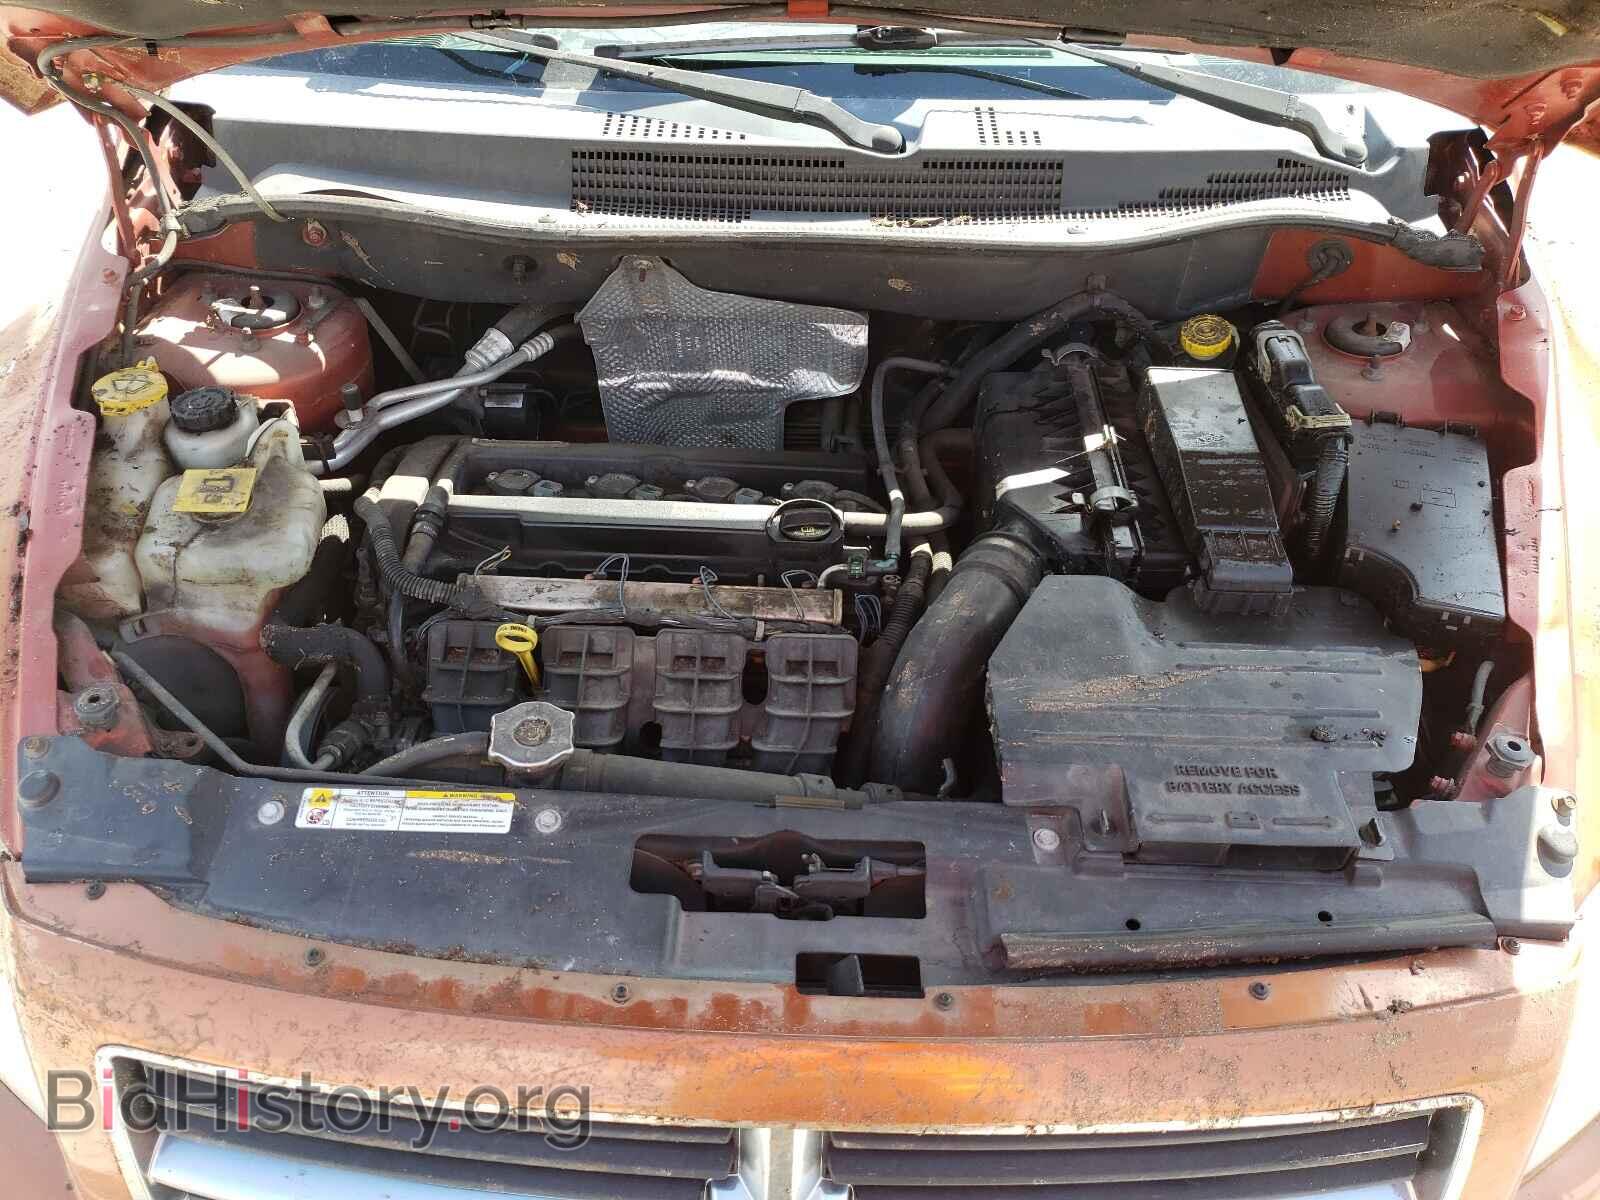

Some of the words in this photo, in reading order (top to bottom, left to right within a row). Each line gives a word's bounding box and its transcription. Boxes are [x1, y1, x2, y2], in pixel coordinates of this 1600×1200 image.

[1174, 764, 1242, 778] REMOVE
[1244, 767, 1280, 779] FOR
[1165, 781, 1232, 795] BATTERY
[1237, 783, 1301, 797] ACCESS
